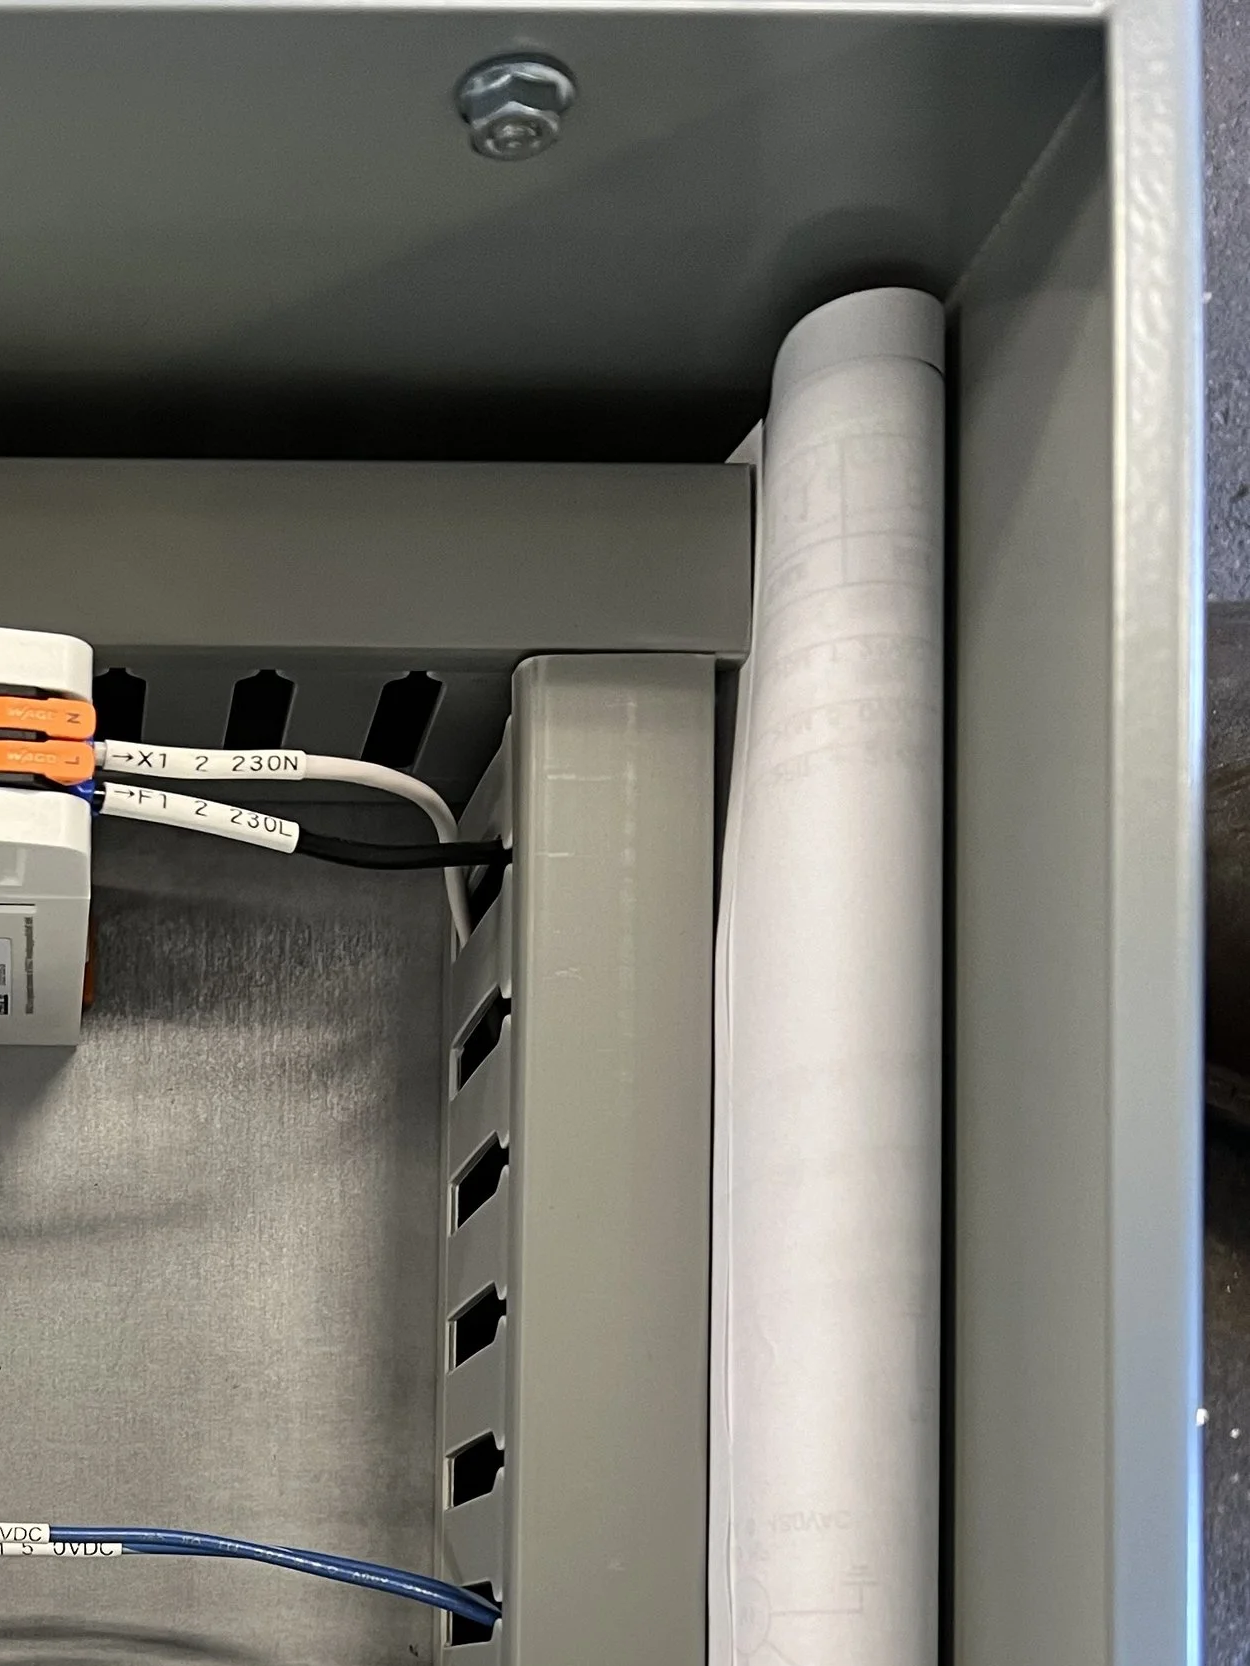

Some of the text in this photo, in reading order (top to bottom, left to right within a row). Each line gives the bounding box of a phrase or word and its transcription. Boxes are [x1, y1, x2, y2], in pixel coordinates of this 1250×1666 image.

[67, 712, 81, 724] N
[137, 752, 300, 773] X1 2 230N
[137, 789, 294, 838] F1 2 230L
